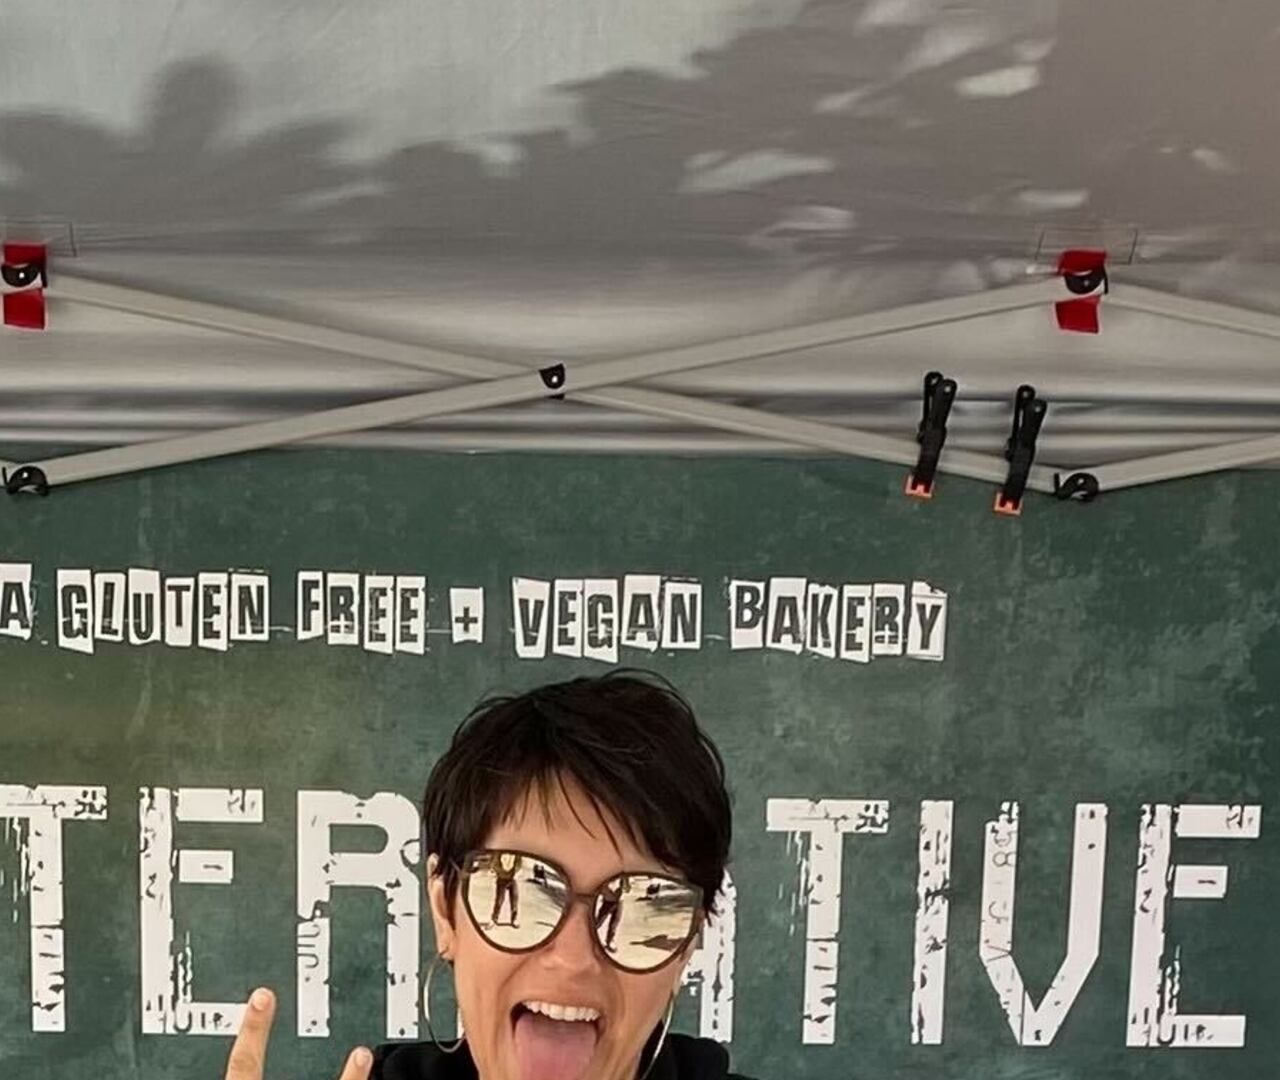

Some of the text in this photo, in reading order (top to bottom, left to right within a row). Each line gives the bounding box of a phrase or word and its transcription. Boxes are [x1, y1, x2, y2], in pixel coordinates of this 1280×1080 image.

[59, 574, 267, 647] GLUTEN
[300, 575, 423, 649] FREE
[516, 582, 699, 655] VEGAN
[732, 583, 944, 656] BAKERY
